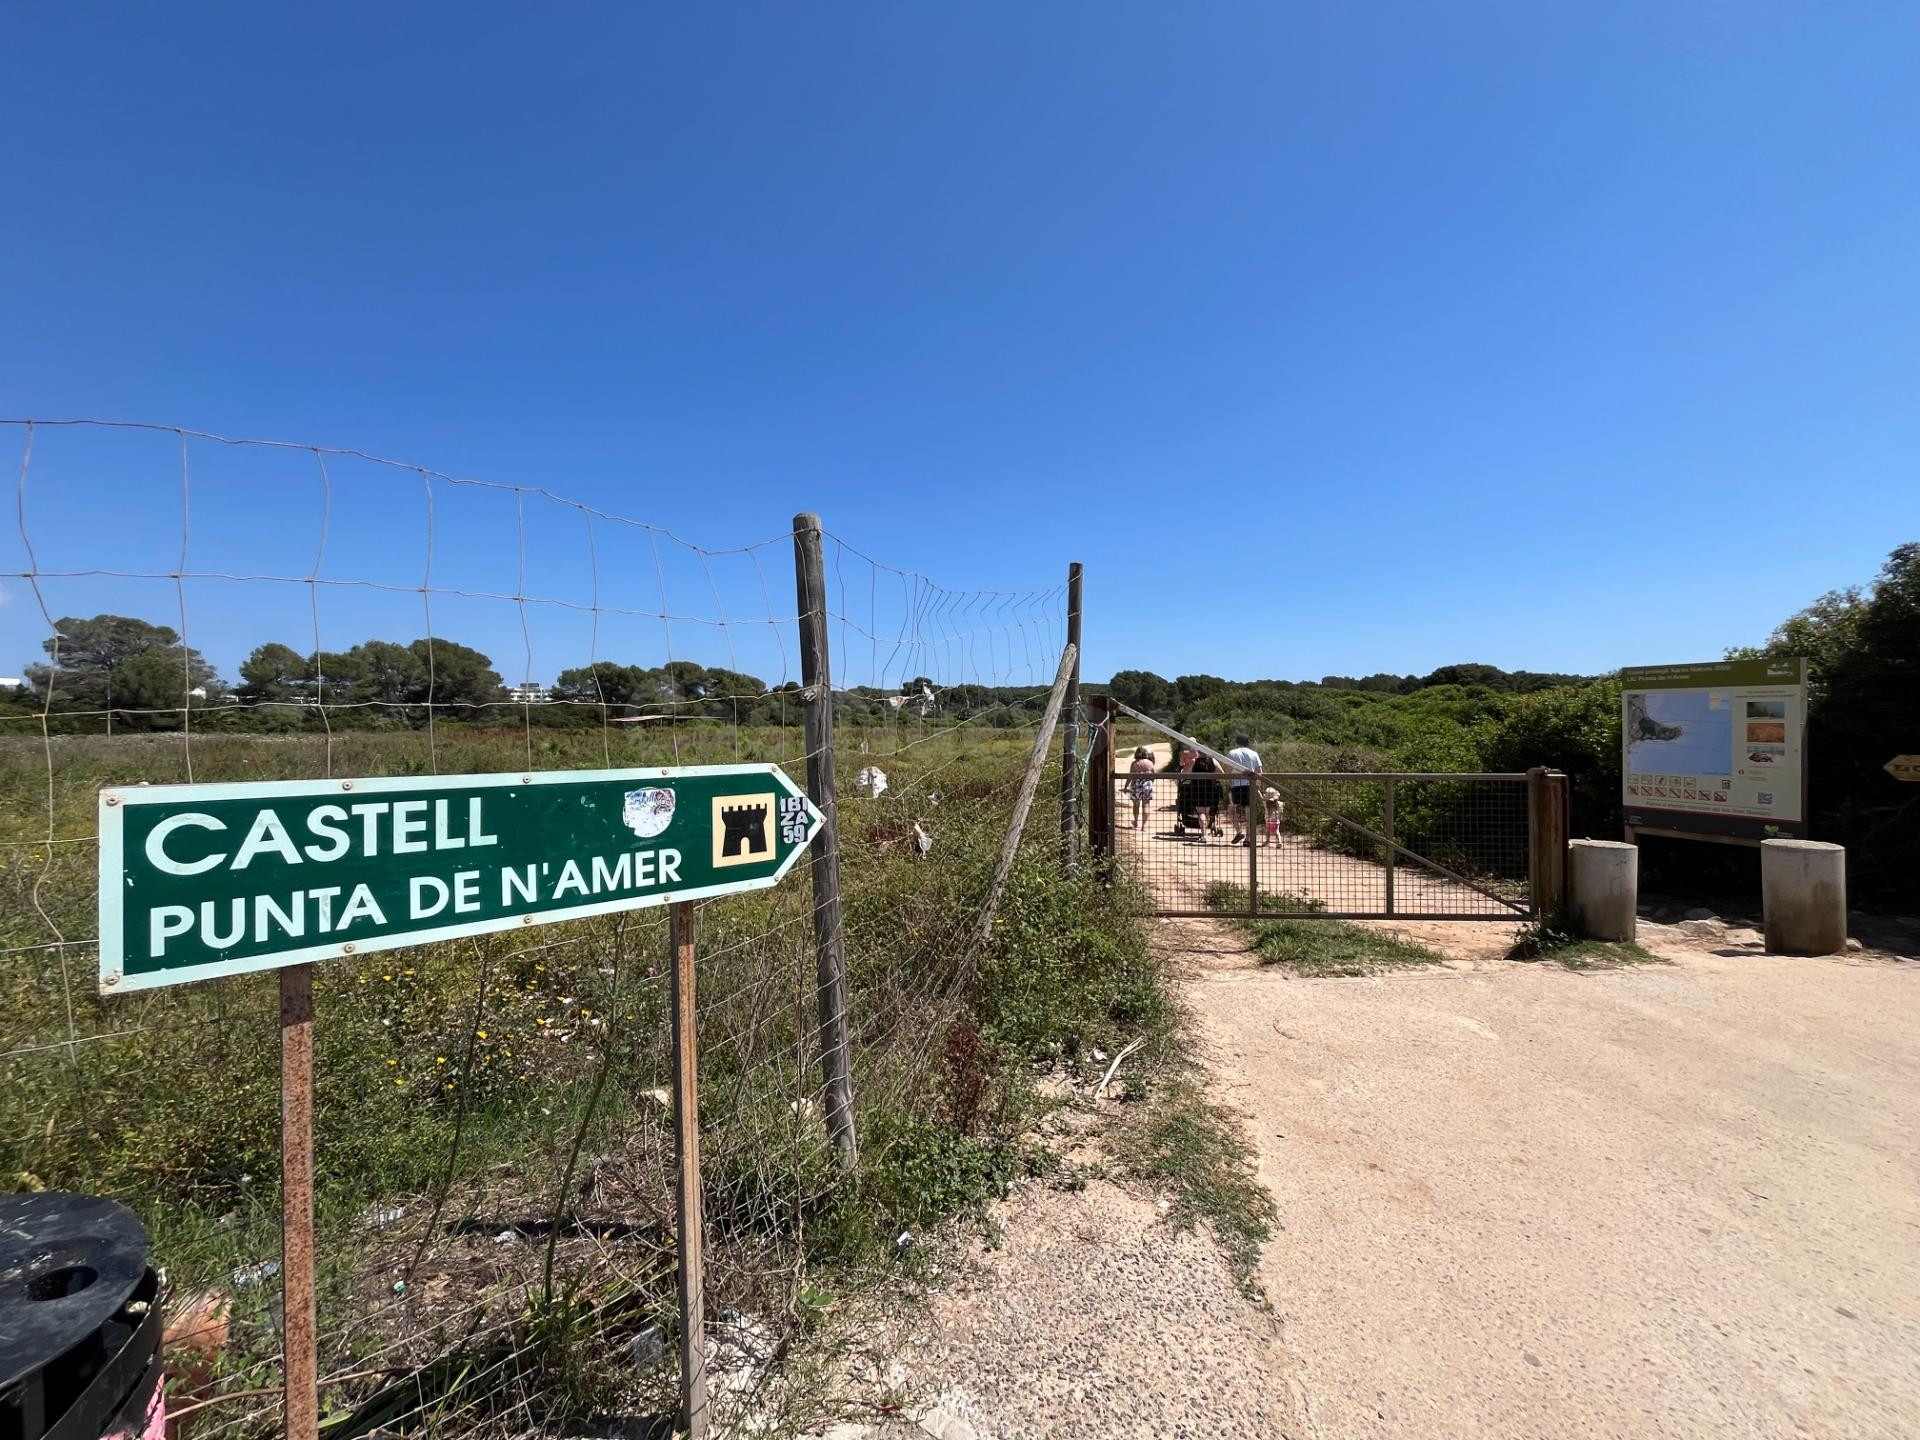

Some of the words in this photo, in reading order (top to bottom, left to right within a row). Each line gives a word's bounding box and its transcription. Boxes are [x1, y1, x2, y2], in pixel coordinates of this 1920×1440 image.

[780, 797, 808, 812] IBI
[780, 811, 809, 826] ZA
[145, 797, 498, 876] CASTELL
[783, 825, 805, 844] 59
[150, 883, 387, 958] PUNTA
[409, 870, 481, 920] DE
[502, 848, 682, 906] N'AMER
